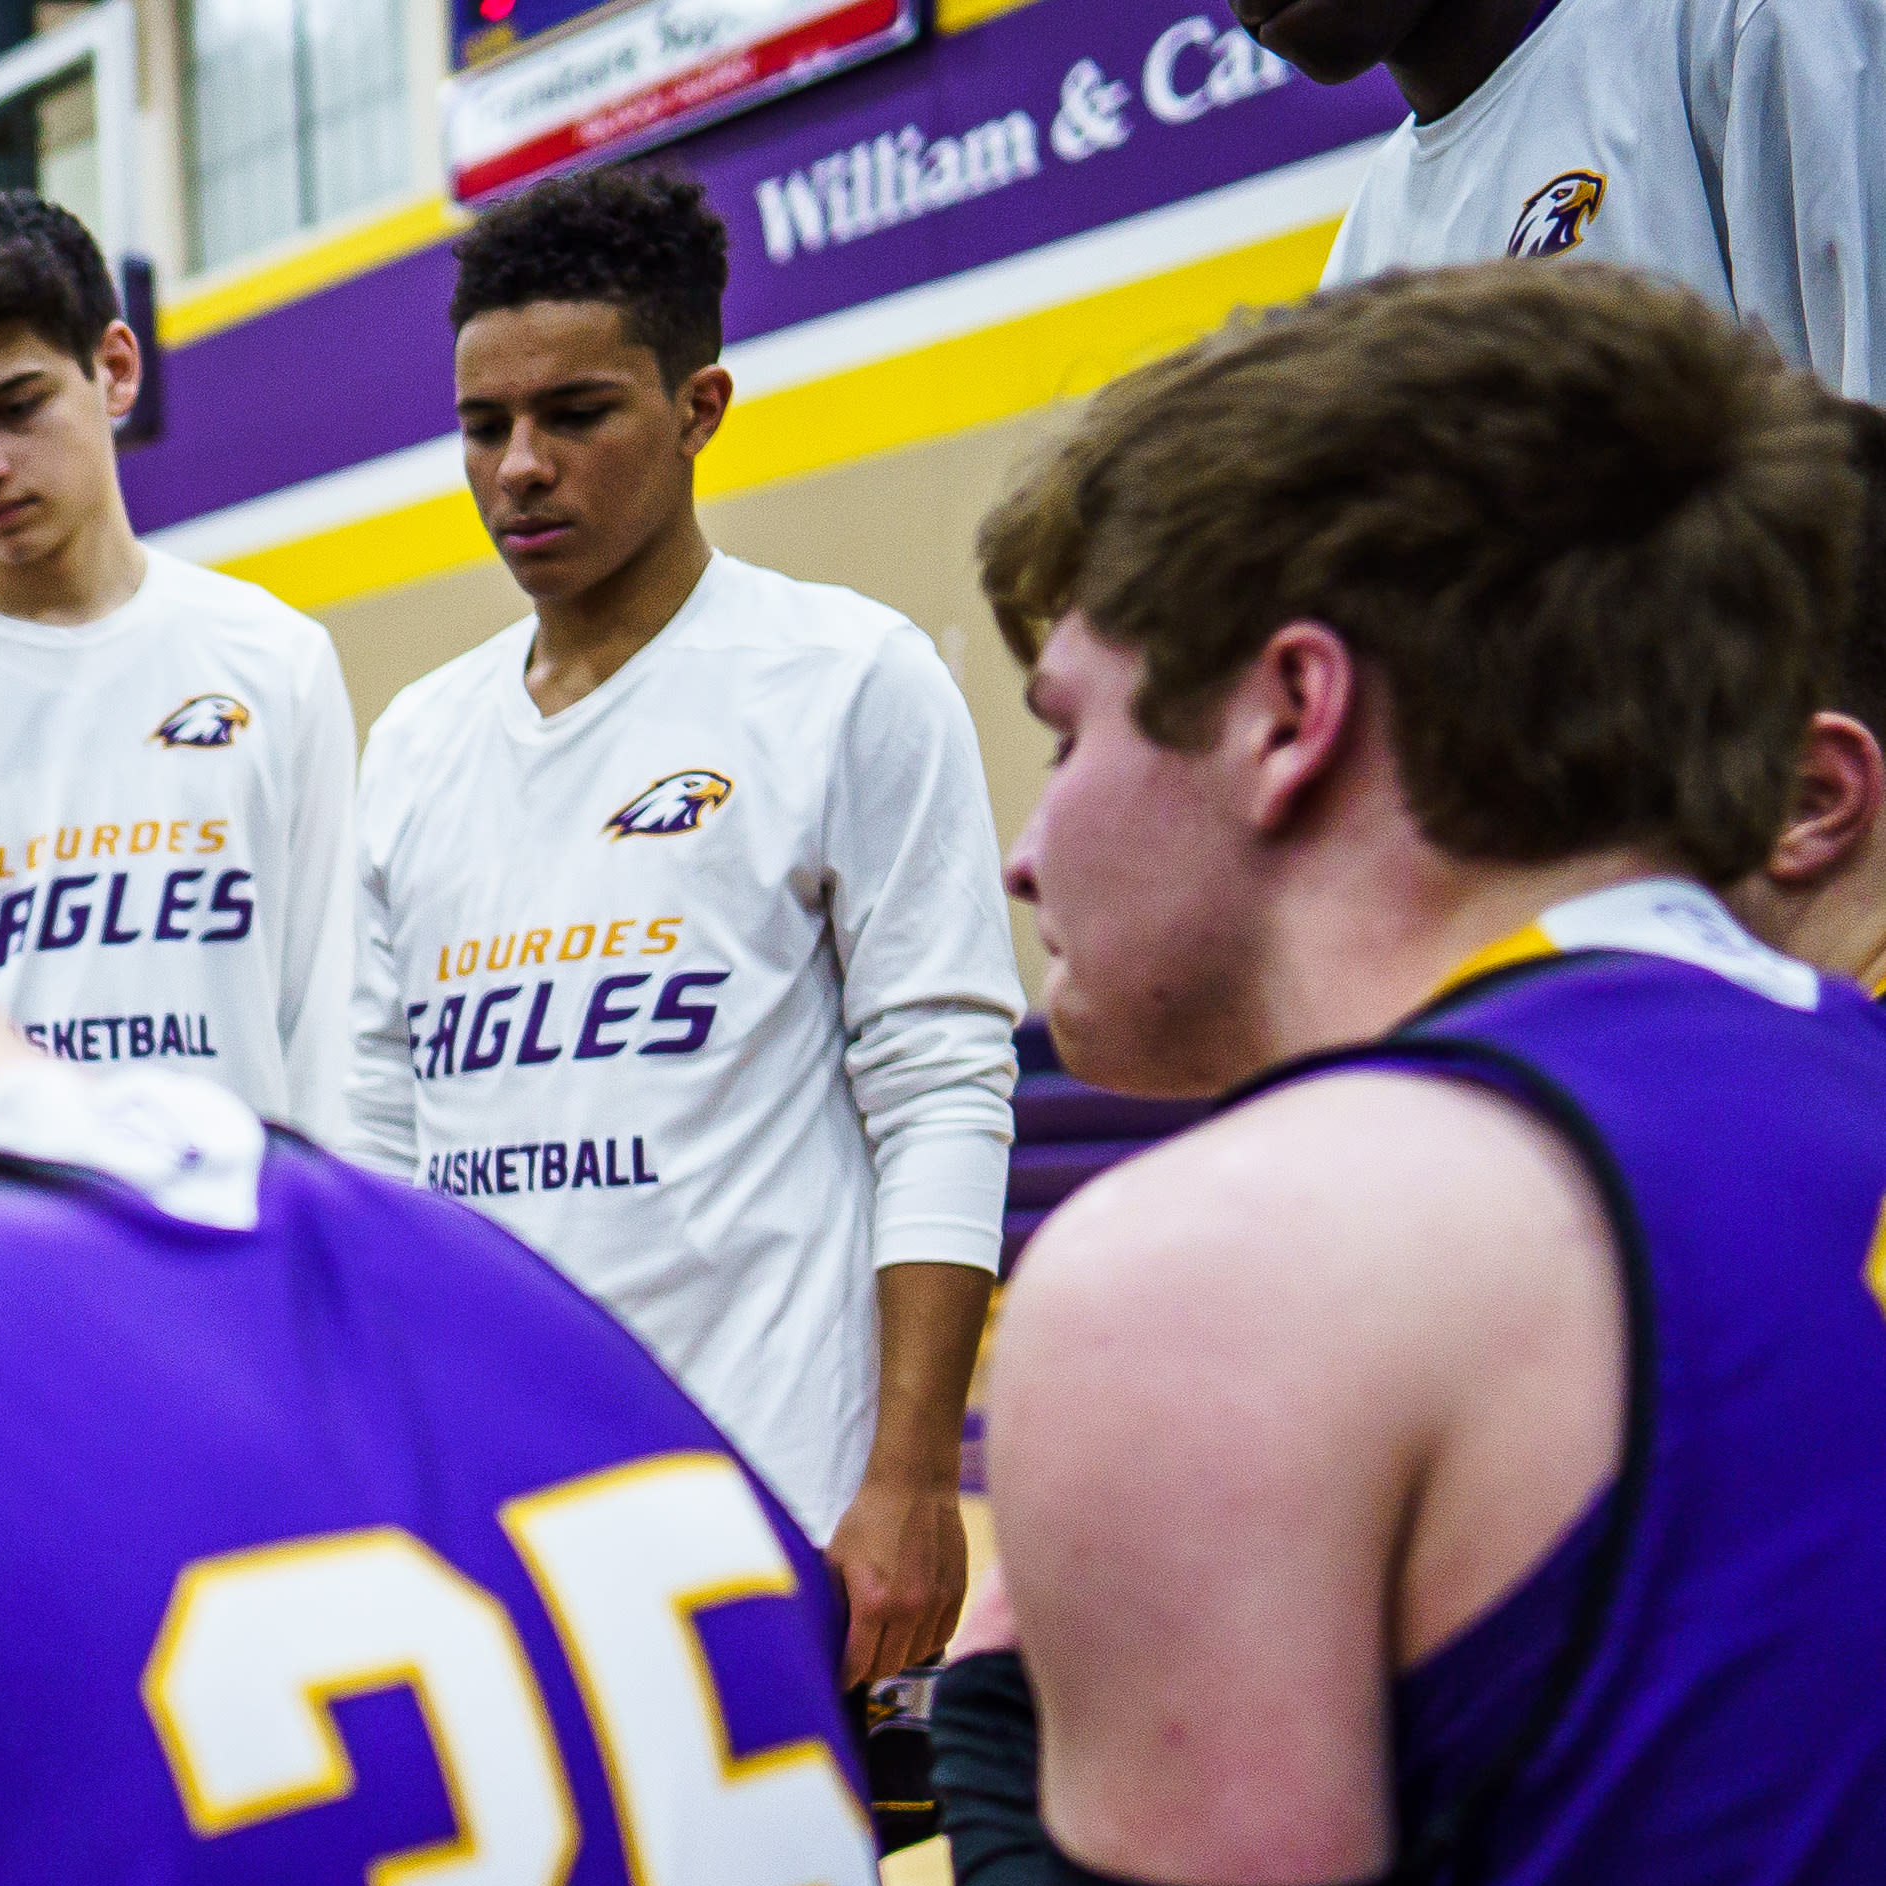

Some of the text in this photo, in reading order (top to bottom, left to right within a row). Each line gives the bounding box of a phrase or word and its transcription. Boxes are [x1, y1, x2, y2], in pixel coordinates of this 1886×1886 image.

[756, 109, 1043, 265] William
[1049, 56, 1132, 163] &
[436, 916, 684, 982] LOURDES
[24, 1011, 219, 1062] SKETBALL
[428, 1135, 660, 1197] BASKETBALL
